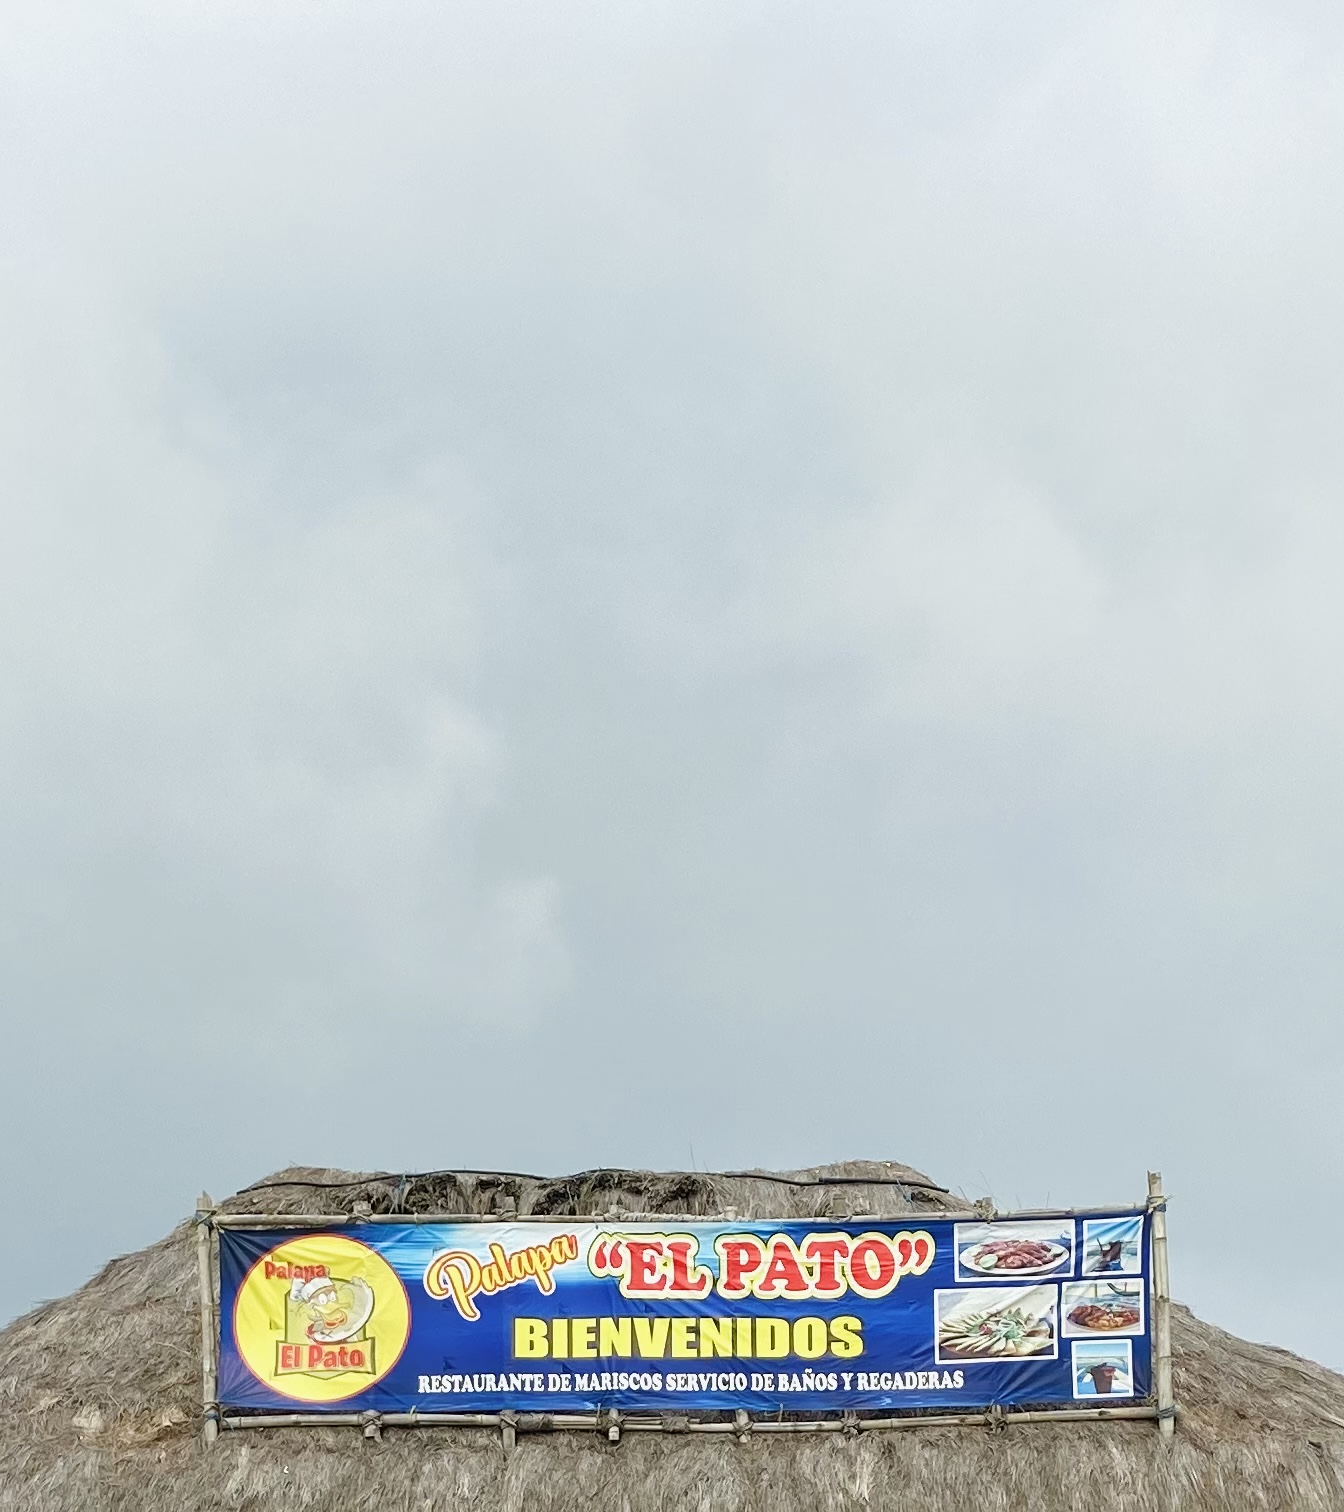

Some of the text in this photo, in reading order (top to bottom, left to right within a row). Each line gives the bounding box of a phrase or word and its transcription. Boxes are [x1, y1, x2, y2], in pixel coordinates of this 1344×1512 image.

[264, 1260, 327, 1283] Palapa
[426, 1234, 579, 1318] Palapa
[513, 1315, 864, 1359] BIENVENIDOS
[281, 1344, 365, 1368] El Pato
[417, 1367, 965, 1393] RESTAURANTE DE MARISCOS SERVICIO DE BAÑOS Y REGADERAS
